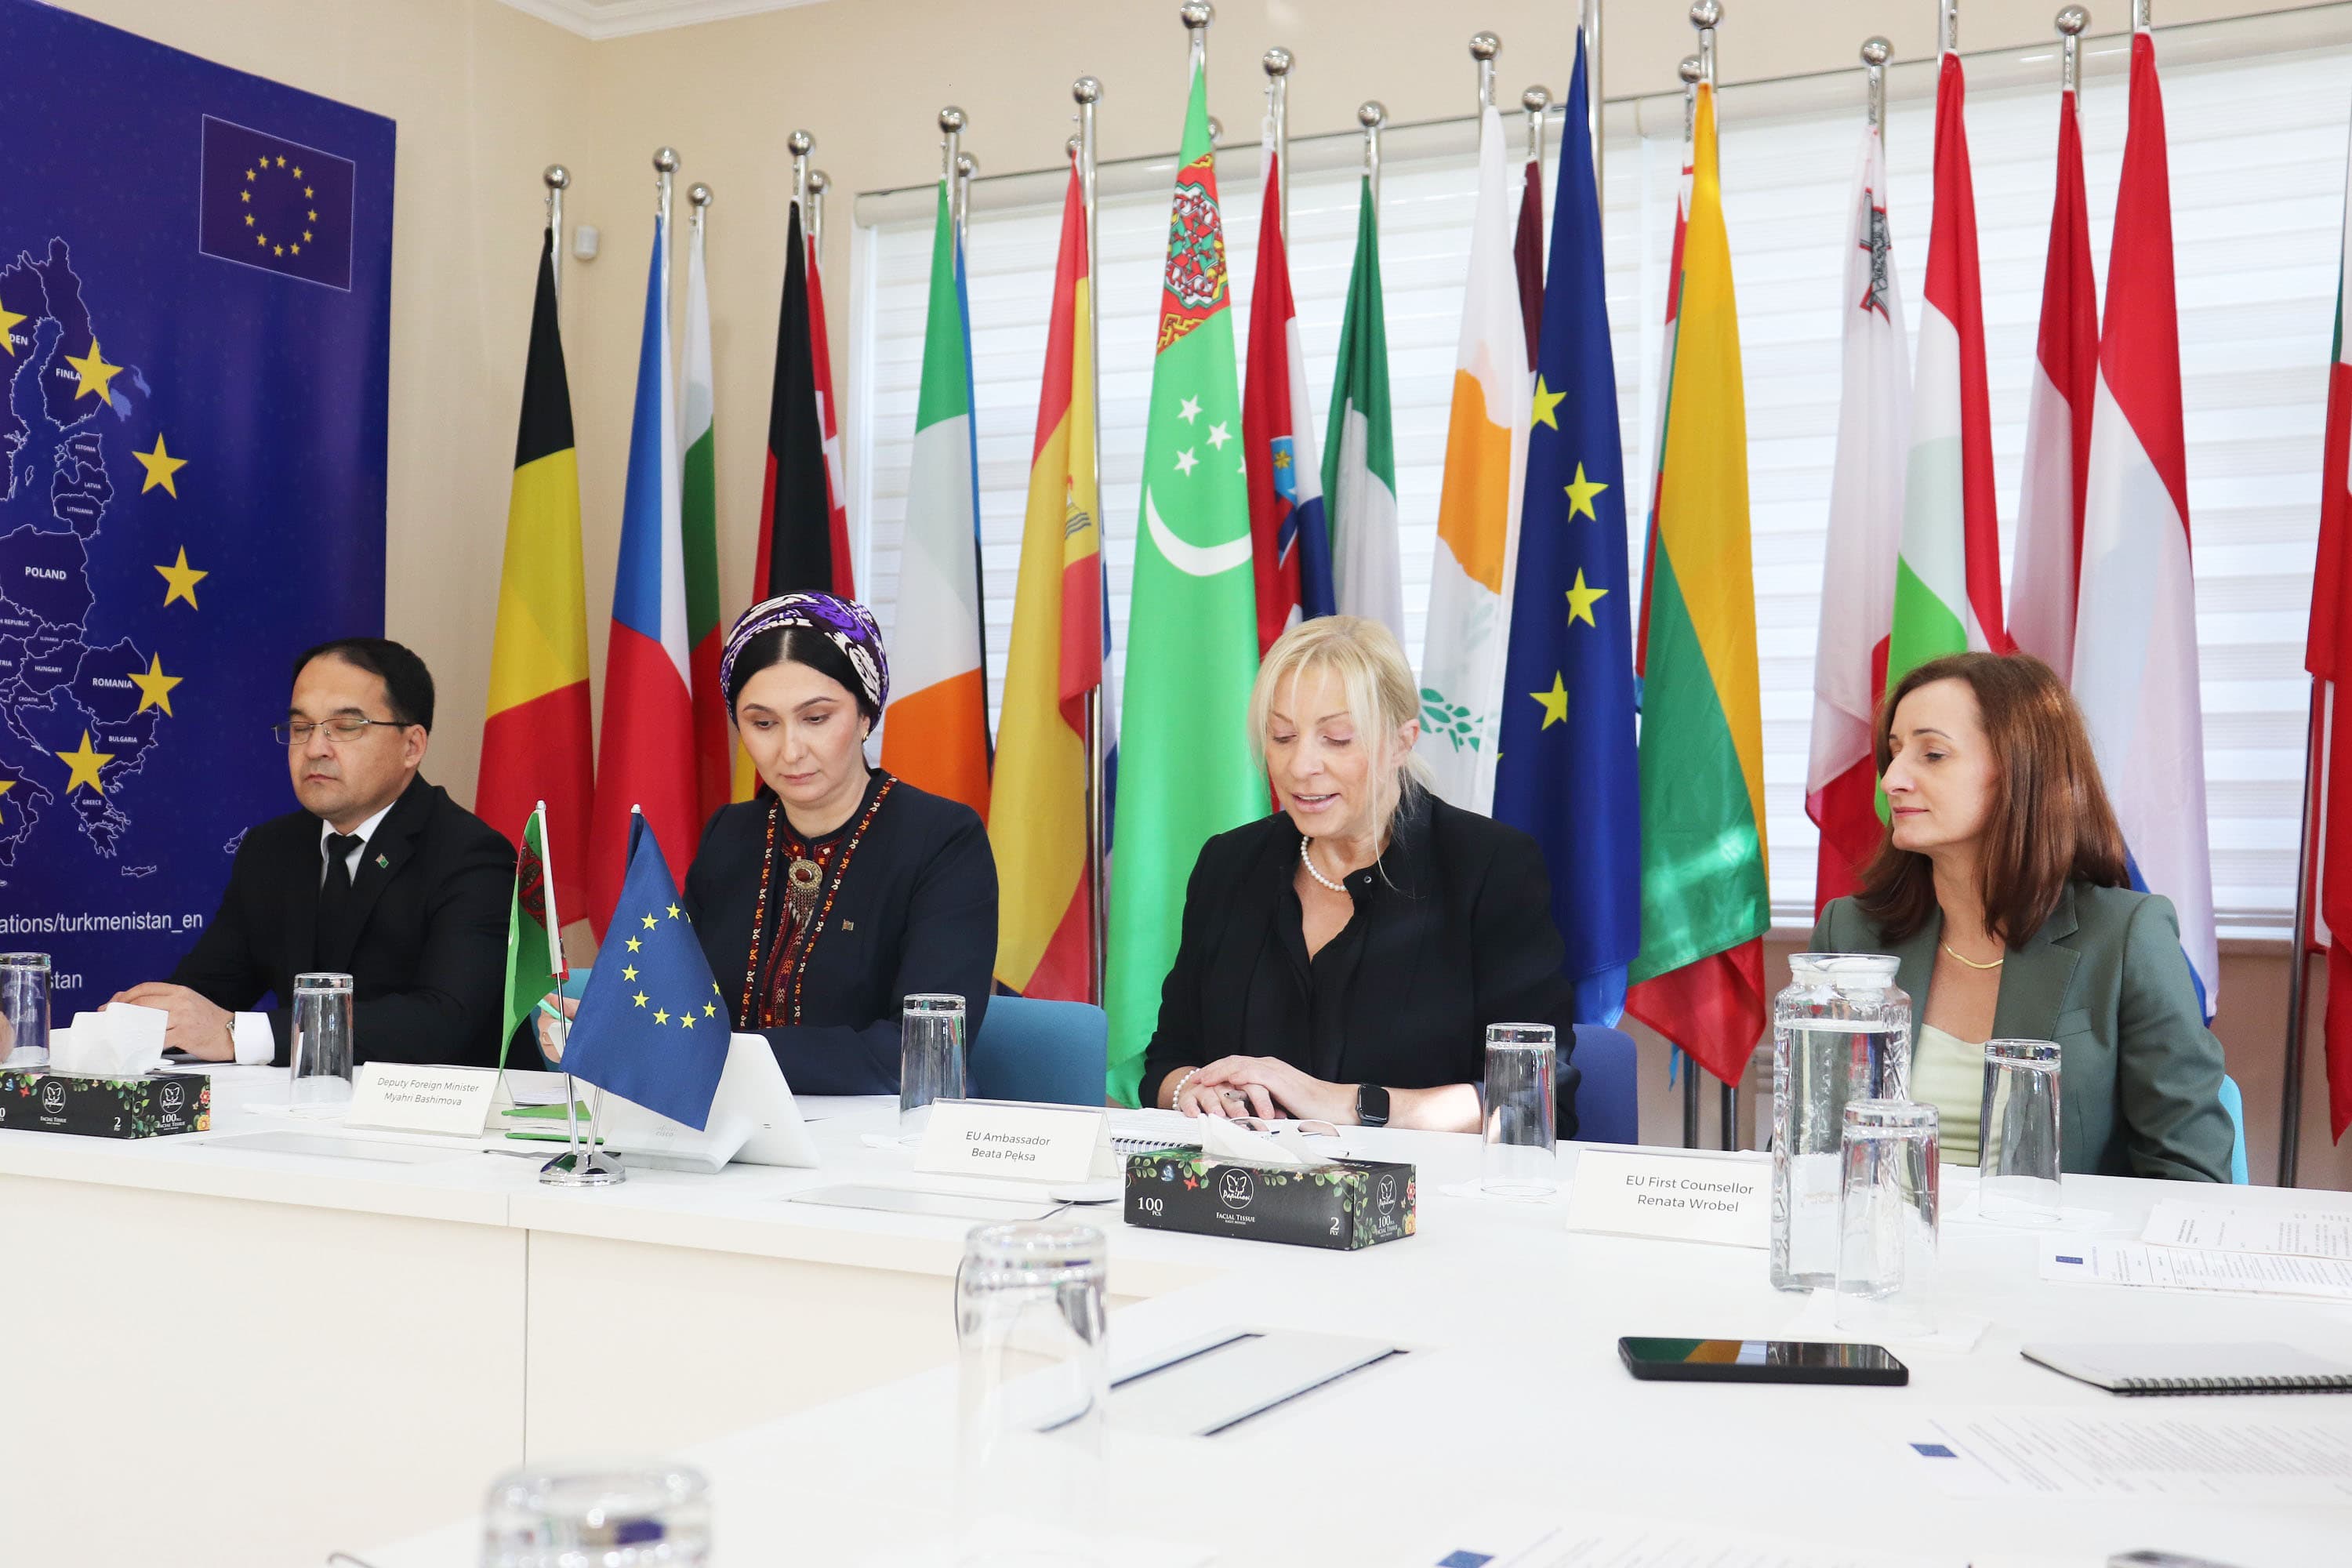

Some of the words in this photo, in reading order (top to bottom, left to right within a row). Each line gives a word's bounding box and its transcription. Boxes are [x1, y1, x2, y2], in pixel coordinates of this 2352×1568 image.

[9, 333, 28, 346] DEN
[56, 368, 82, 381] FINLA
[74, 444, 96, 452] ESTONIA
[67, 506, 93, 514] LITHUANIA
[25, 566, 67, 580] POLAND
[93, 677, 132, 689] ROMANIA
[0, 911, 203, 934] ations/turkmenistan_en
[377, 1077, 408, 1088] Deputy
[410, 1080, 442, 1091] Foreign
[444, 1083, 480, 1093] Minister
[384, 1092, 413, 1106] Myahri
[415, 1094, 463, 1106] Bashimova
[114, 1116, 122, 1127] 2
[162, 1113, 176, 1123] 100
[965, 1131, 982, 1141] EU
[983, 1132, 1051, 1146] Ambassador
[971, 1148, 1002, 1159] Beata
[1625, 1174, 1645, 1186] EU
[1648, 1176, 1677, 1189] First
[1680, 1179, 1755, 1195] Counsellor
[1138, 1196, 1163, 1211] 100
[1637, 1194, 1686, 1208] Renata
[1689, 1198, 1740, 1212] Wrobel
[1216, 1211, 1235, 1221] FACIAL
[1236, 1214, 1255, 1223] TISSUE
[1330, 1217, 1340, 1230] 2
[1378, 1215, 1391, 1229] 100
